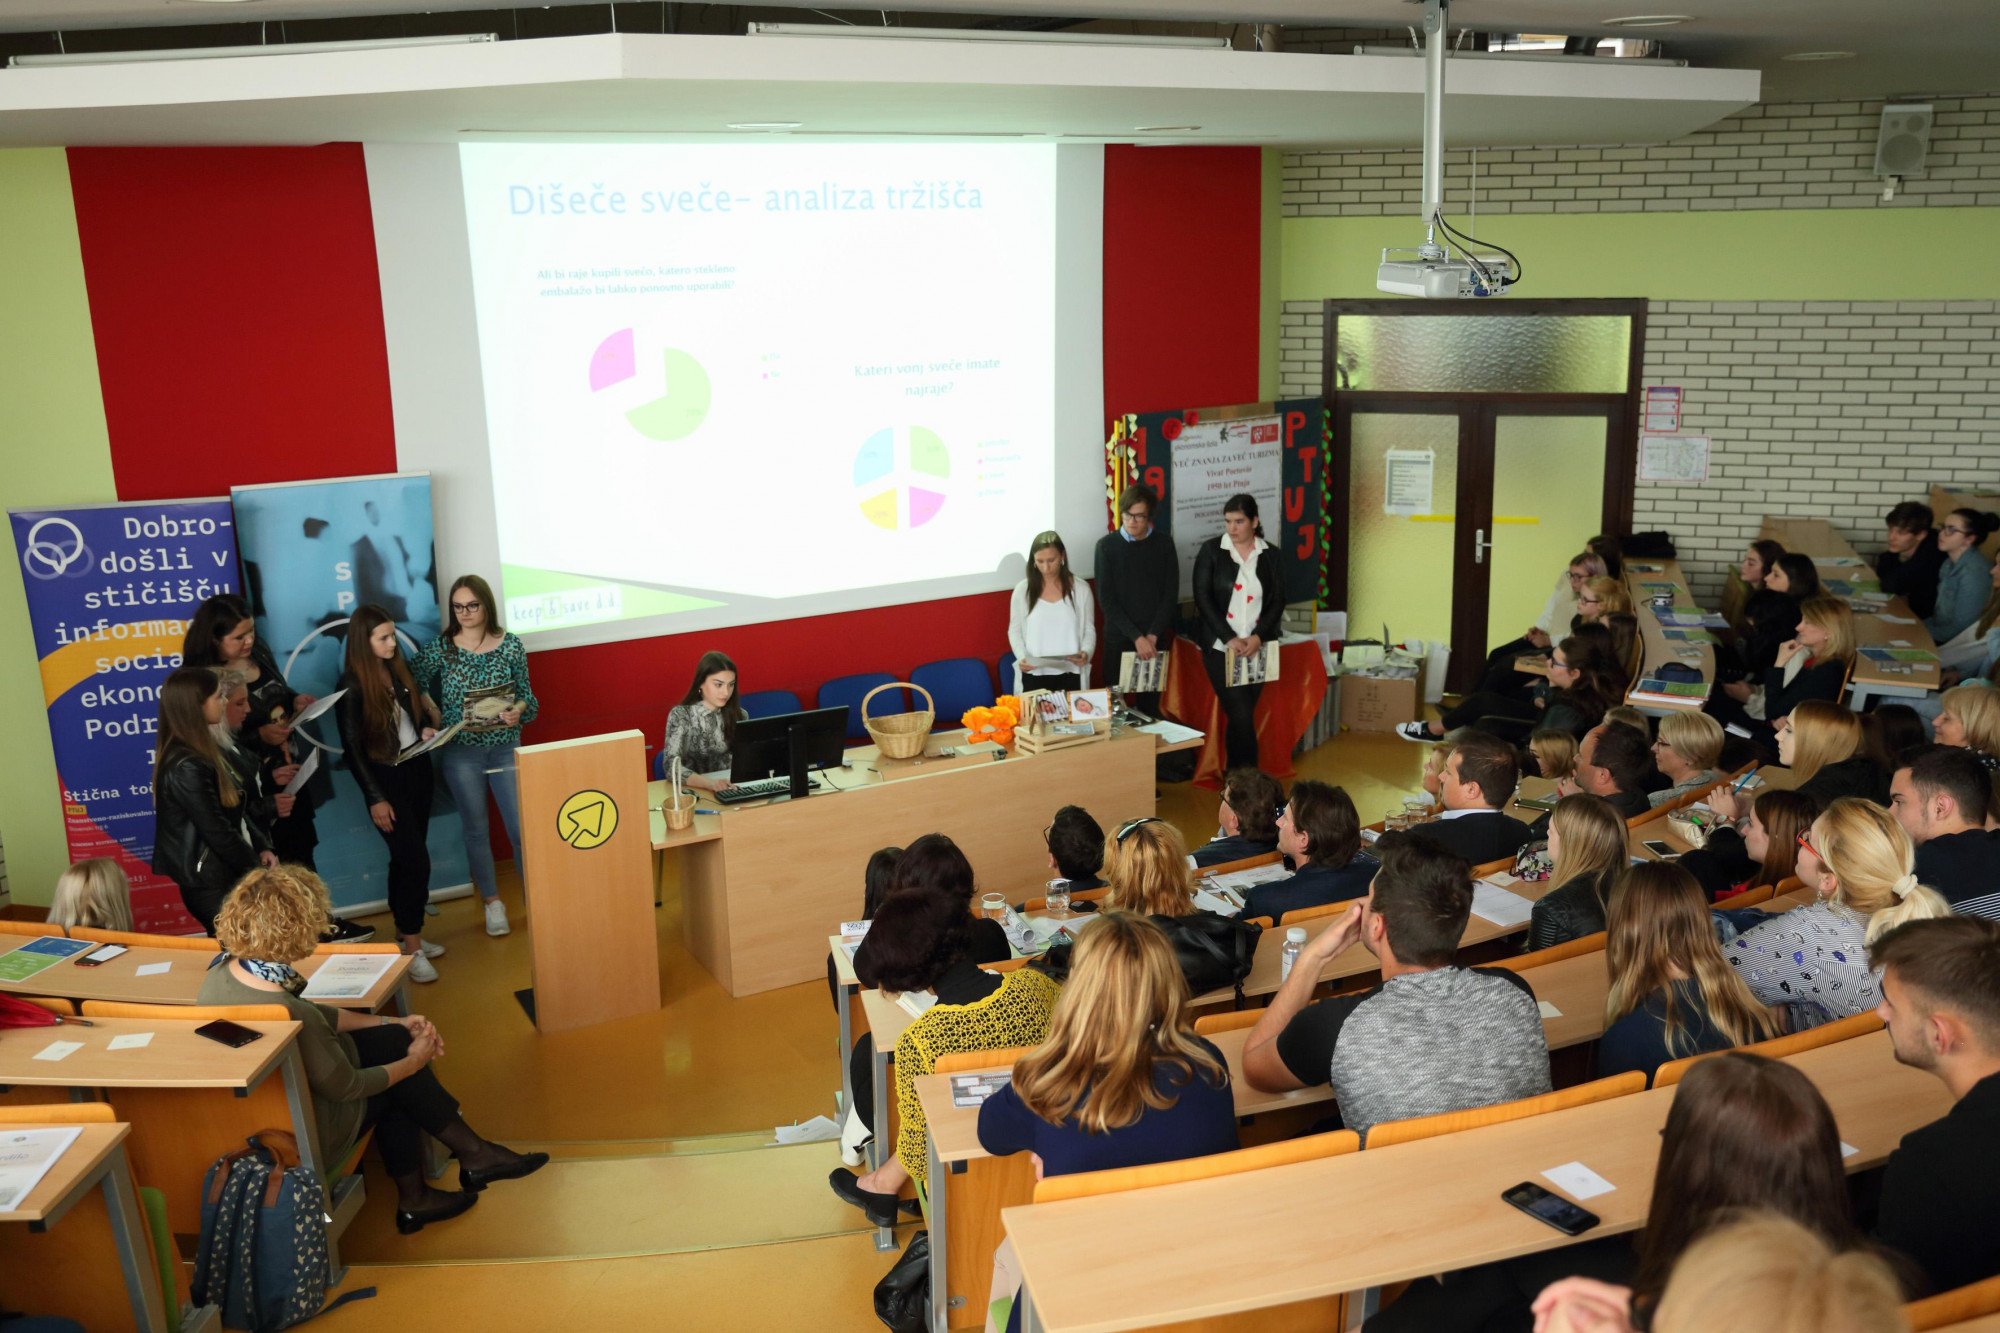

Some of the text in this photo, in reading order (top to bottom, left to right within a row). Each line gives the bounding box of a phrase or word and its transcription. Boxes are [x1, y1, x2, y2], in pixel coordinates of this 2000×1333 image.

[508, 181, 628, 215] Dišeče
[764, 181, 876, 212] analiza
[886, 180, 984, 210] tržišča
[536, 269, 552, 280] Ali
[555, 268, 566, 280] bi
[568, 268, 588, 281] raje
[591, 267, 621, 281] kupili
[658, 265, 691, 277] katero
[694, 264, 736, 275] stekleno
[540, 280, 735, 297] embalažo bi lahko ponovno uporabili?
[854, 357, 1001, 377] Kateri vonj sveče imate
[905, 381, 954, 398] najraje?
[1249, 449, 1279, 460] TURIZMA
[123, 516, 231, 540] Dobro-
[100, 548, 229, 574] došli v
[513, 604, 542, 625] keep
[563, 600, 589, 614] save
[95, 647, 183, 674] socia
[85, 713, 158, 740] Podr
[63, 788, 120, 802] Stična
